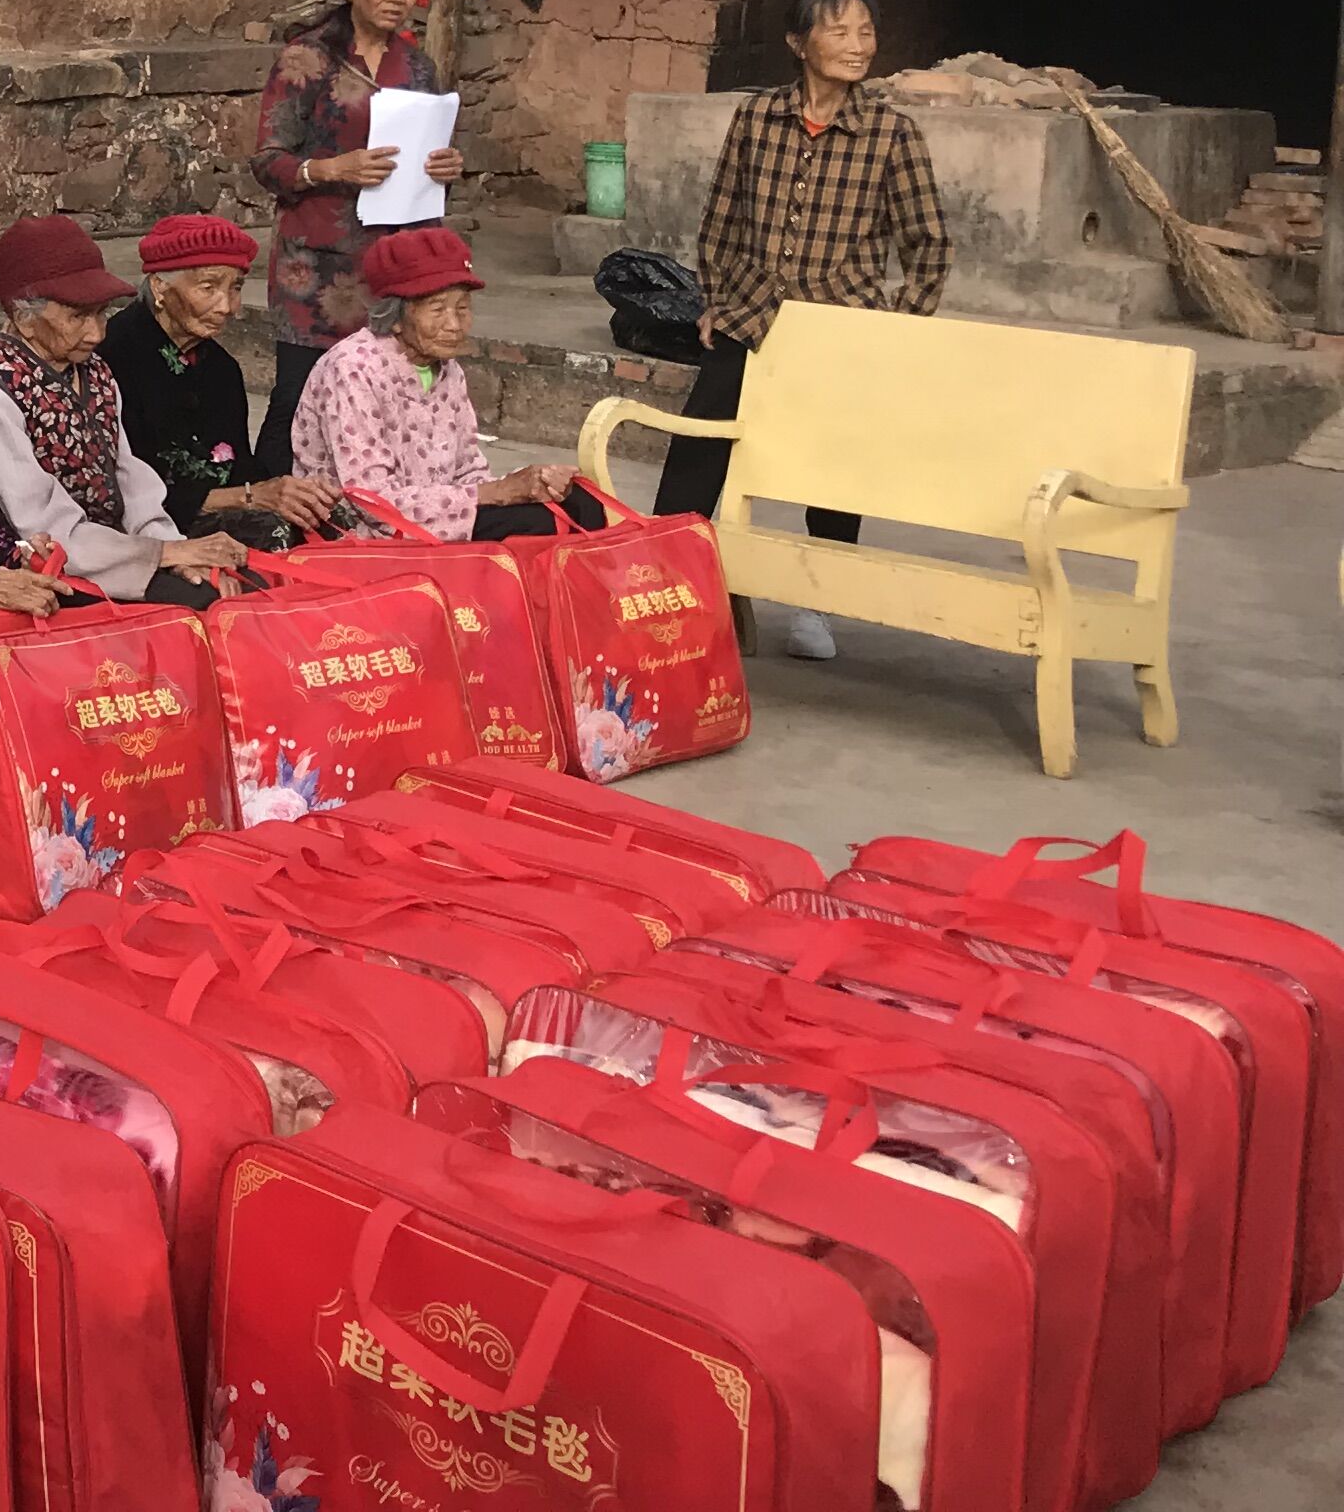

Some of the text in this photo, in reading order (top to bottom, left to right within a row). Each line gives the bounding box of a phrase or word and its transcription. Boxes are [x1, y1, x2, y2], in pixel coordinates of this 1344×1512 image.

[453, 607, 481, 632] 毯
[619, 584, 698, 622] 超柔软毛毯
[299, 645, 416, 691] 超柔软毛毯
[75, 687, 182, 730] 超柔软毛毯
[503, 743, 541, 754] HEALTH
[348, 1454, 425, 1508] Super
